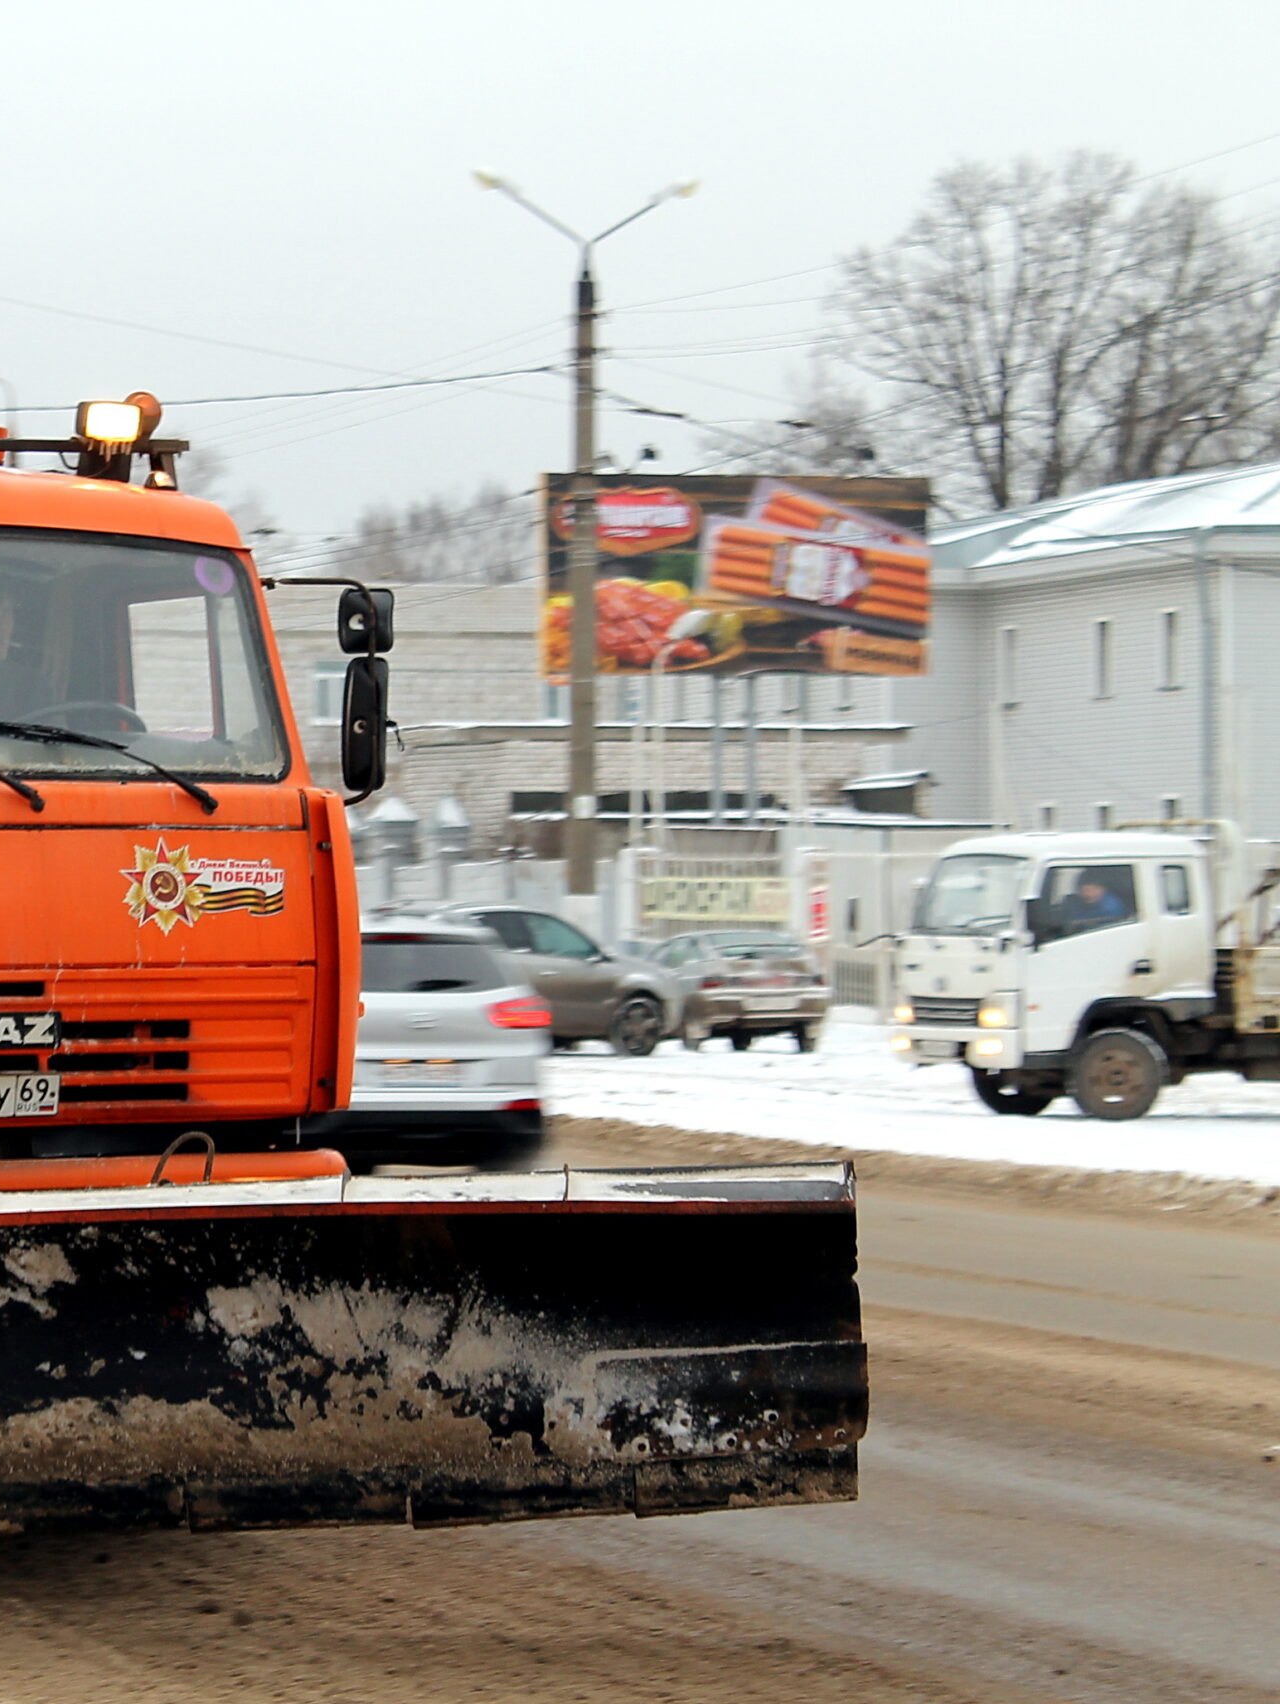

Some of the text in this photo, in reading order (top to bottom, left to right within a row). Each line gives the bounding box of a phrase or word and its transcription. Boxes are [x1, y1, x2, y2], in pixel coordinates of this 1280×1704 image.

[212, 870, 285, 884] ПОБЕДЫ!
[19, 1078, 49, 1102] 69
[16, 1102, 38, 1112] RUS
